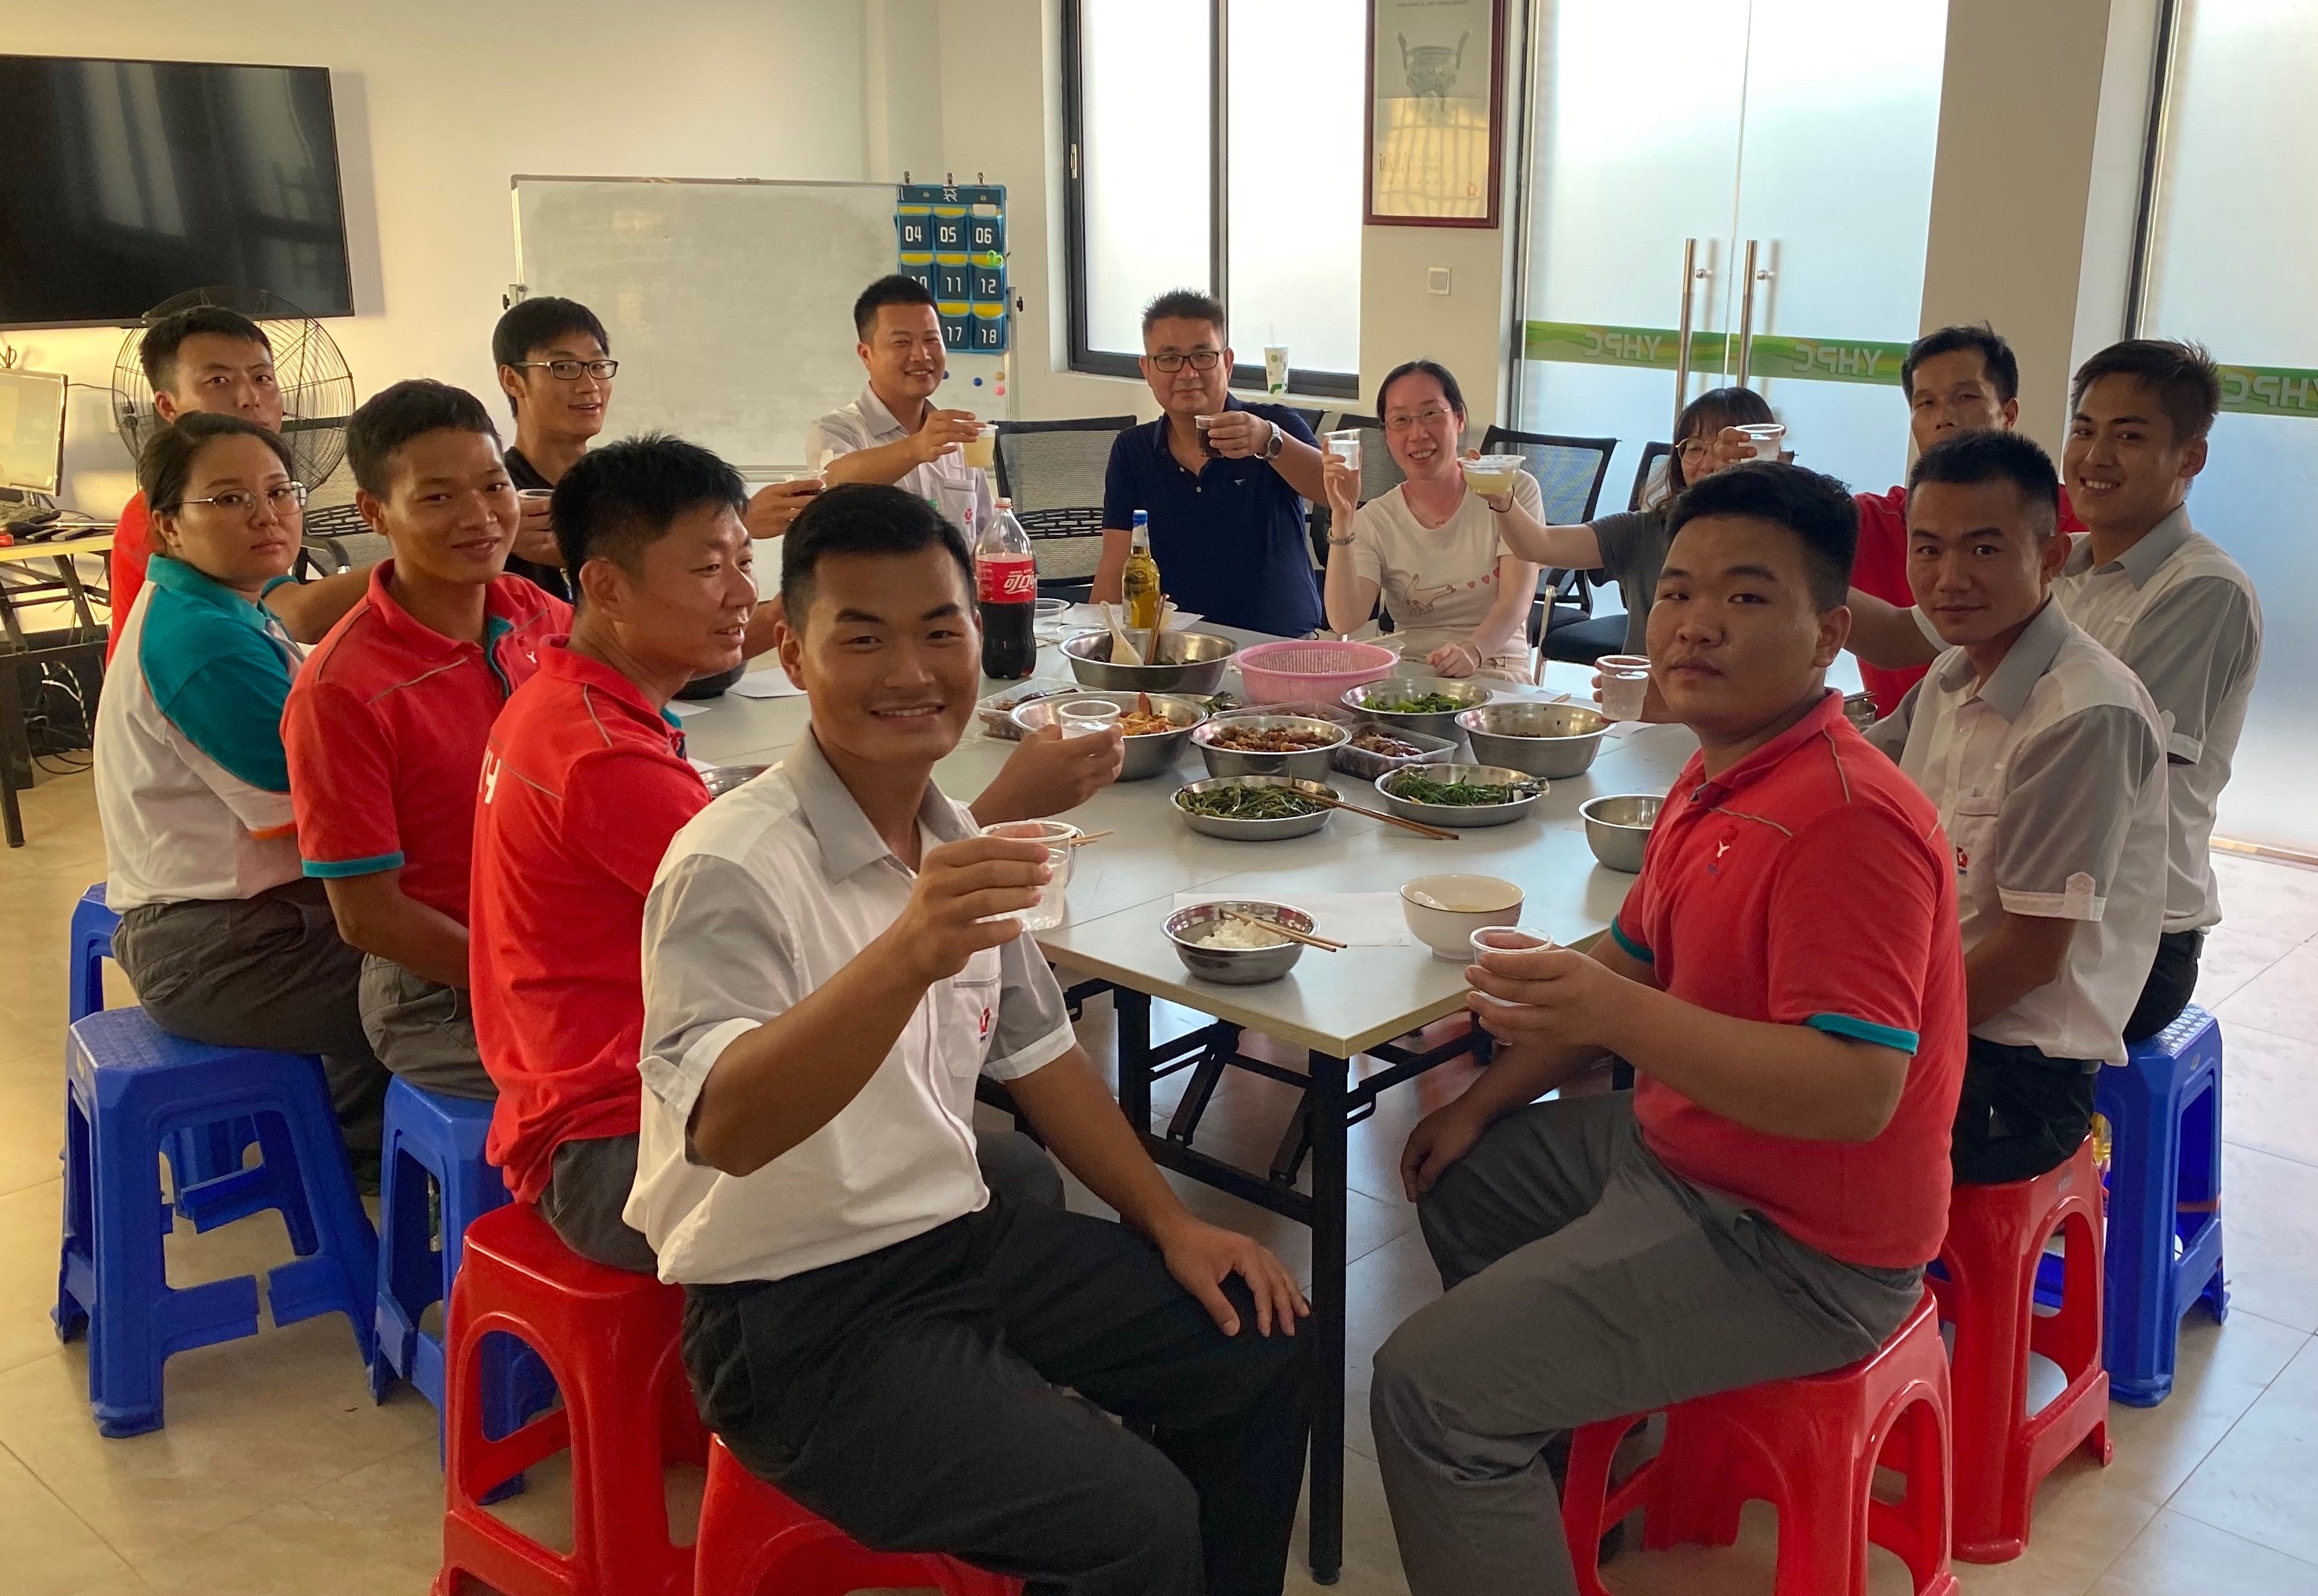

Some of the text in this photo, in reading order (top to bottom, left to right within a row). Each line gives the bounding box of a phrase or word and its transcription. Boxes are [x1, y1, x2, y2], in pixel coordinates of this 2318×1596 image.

[905, 225, 922, 242] 04
[939, 226, 957, 242] 05
[975, 227, 992, 244] 06
[911, 275, 928, 290] 0
[946, 277, 961, 292] 11
[981, 278, 996, 294] 12
[947, 326, 962, 342] 17
[982, 329, 996, 344] 18
